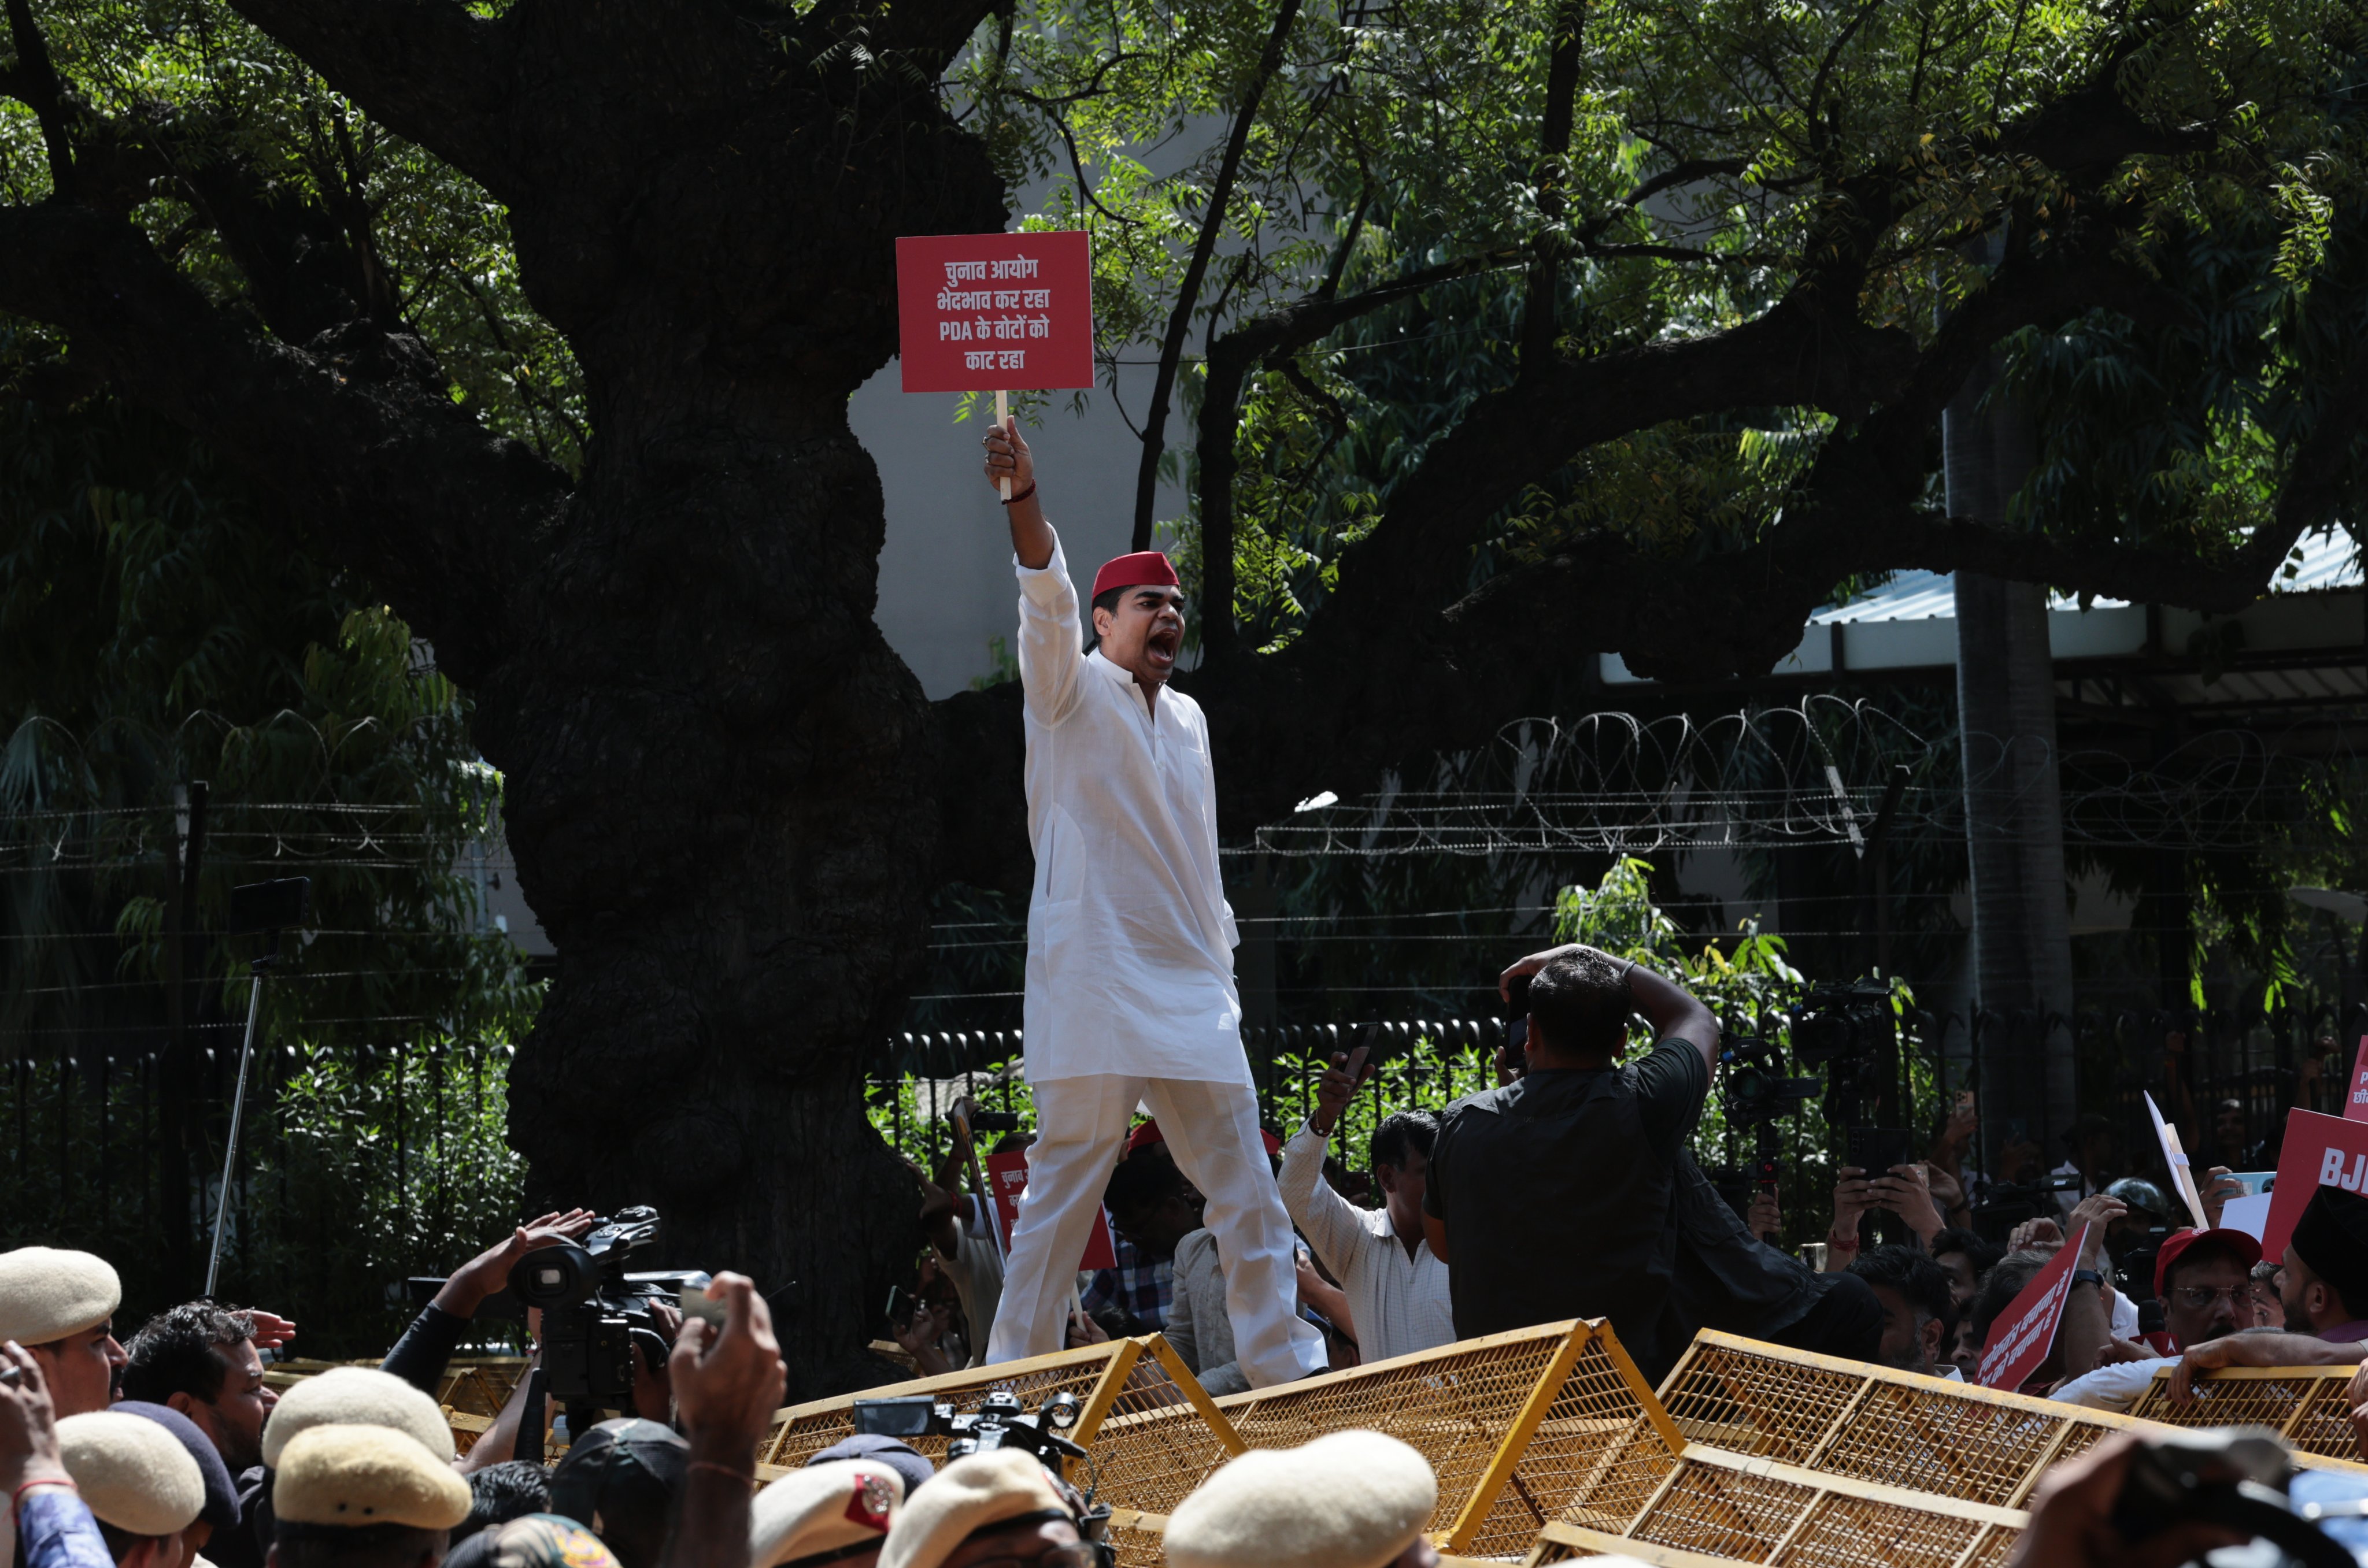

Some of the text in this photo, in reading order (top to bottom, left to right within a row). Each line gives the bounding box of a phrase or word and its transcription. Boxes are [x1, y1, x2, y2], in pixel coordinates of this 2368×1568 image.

[944, 254, 1038, 287] चुनाव आयोग
[937, 287, 1050, 311] भेदभाव कर रहा
[939, 313, 1050, 341] PDA के वोटों को
[964, 350, 1025, 370] काट रहा
[1001, 1169, 1024, 1189] चुनाव
[1978, 1267, 2070, 1379] लोकतंत्र बचाना है
[1991, 1351, 2009, 1384] को
[2008, 1317, 2045, 1367] बचाना
[2043, 1301, 2057, 1332] है
